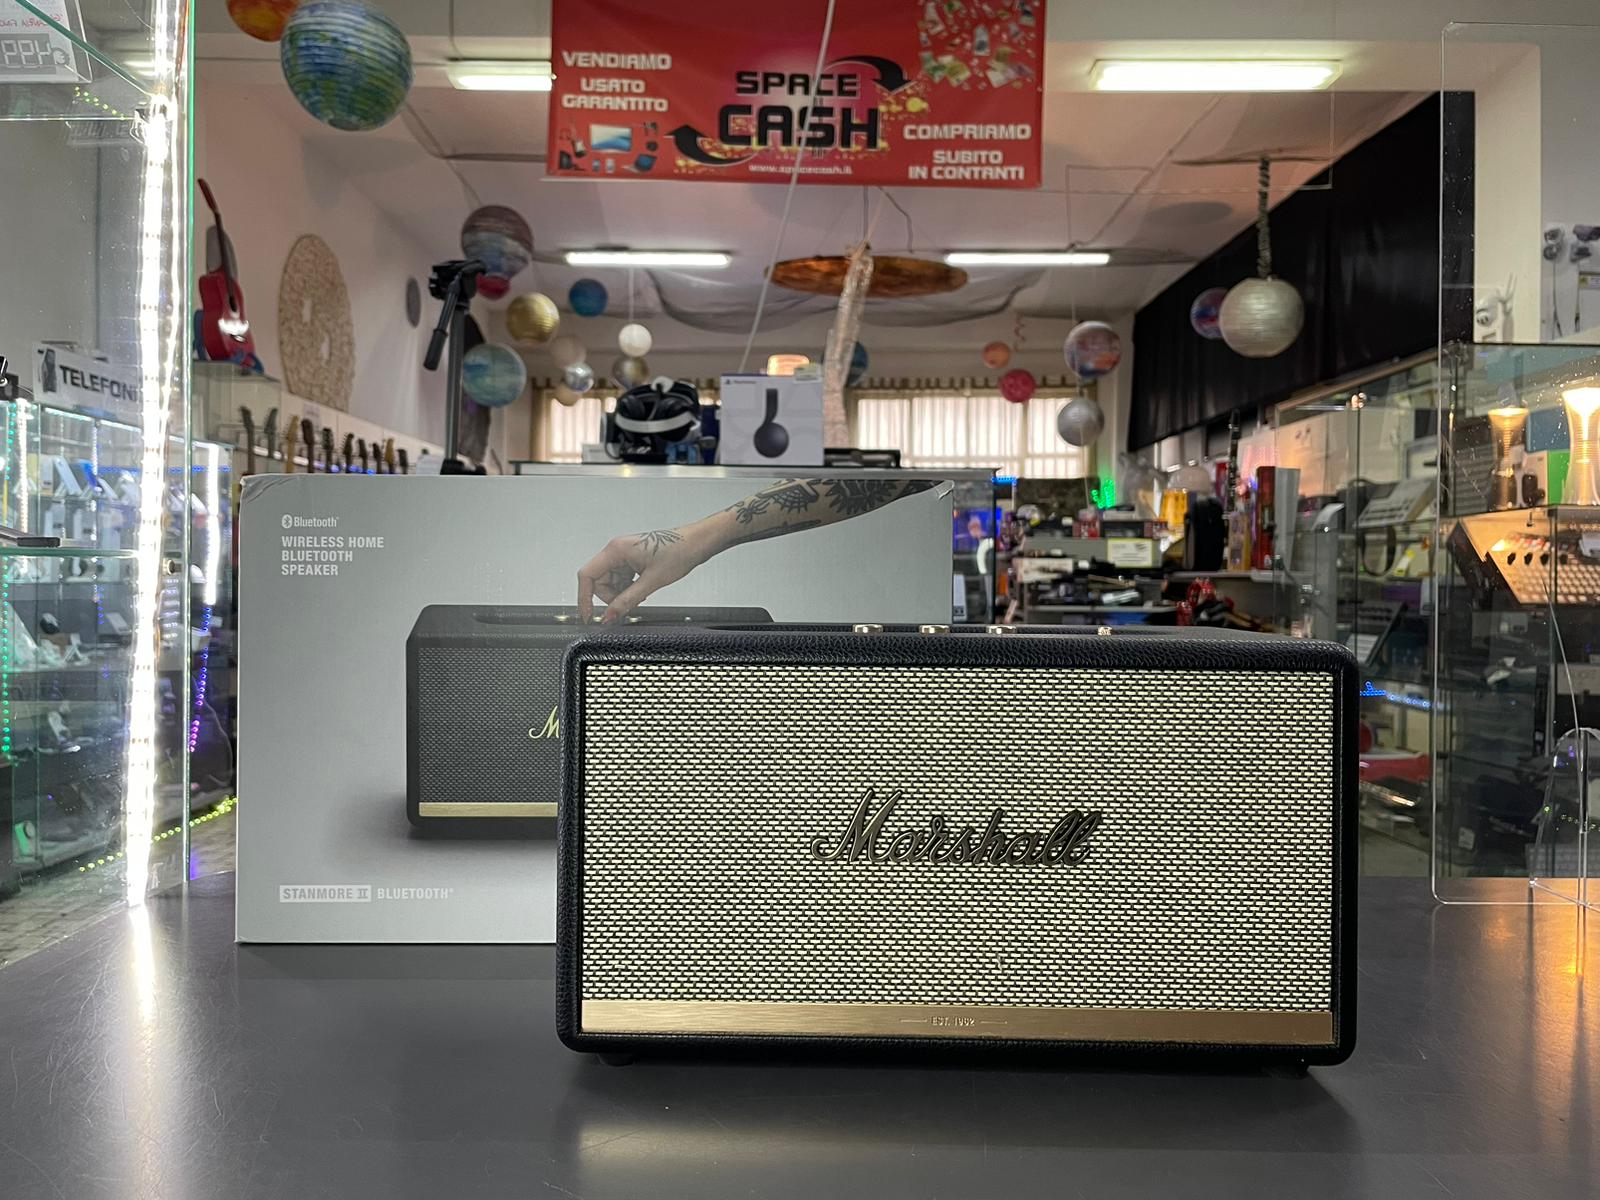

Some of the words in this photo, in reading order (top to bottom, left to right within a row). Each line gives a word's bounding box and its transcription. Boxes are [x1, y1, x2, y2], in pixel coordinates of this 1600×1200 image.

[562, 51, 672, 70] VENDIAMO
[581, 78, 645, 93] USATO
[736, 72, 858, 96] SPACE
[562, 94, 669, 112] GARANTITO
[719, 104, 879, 149] CASH
[903, 124, 1032, 140] COMPRIAMO
[932, 150, 1003, 164] SUBITO
[908, 166, 928, 179] IN
[931, 166, 1025, 180] CONTANTI
[281, 536, 345, 548] WIRELESS
[348, 536, 385, 548] HOME
[281, 550, 353, 562] BLUETOOTH
[281, 564, 339, 576] SPEAKER
[811, 787, 1101, 866] Marshall
[282, 888, 353, 900] STANMORE
[357, 888, 369, 900] II
